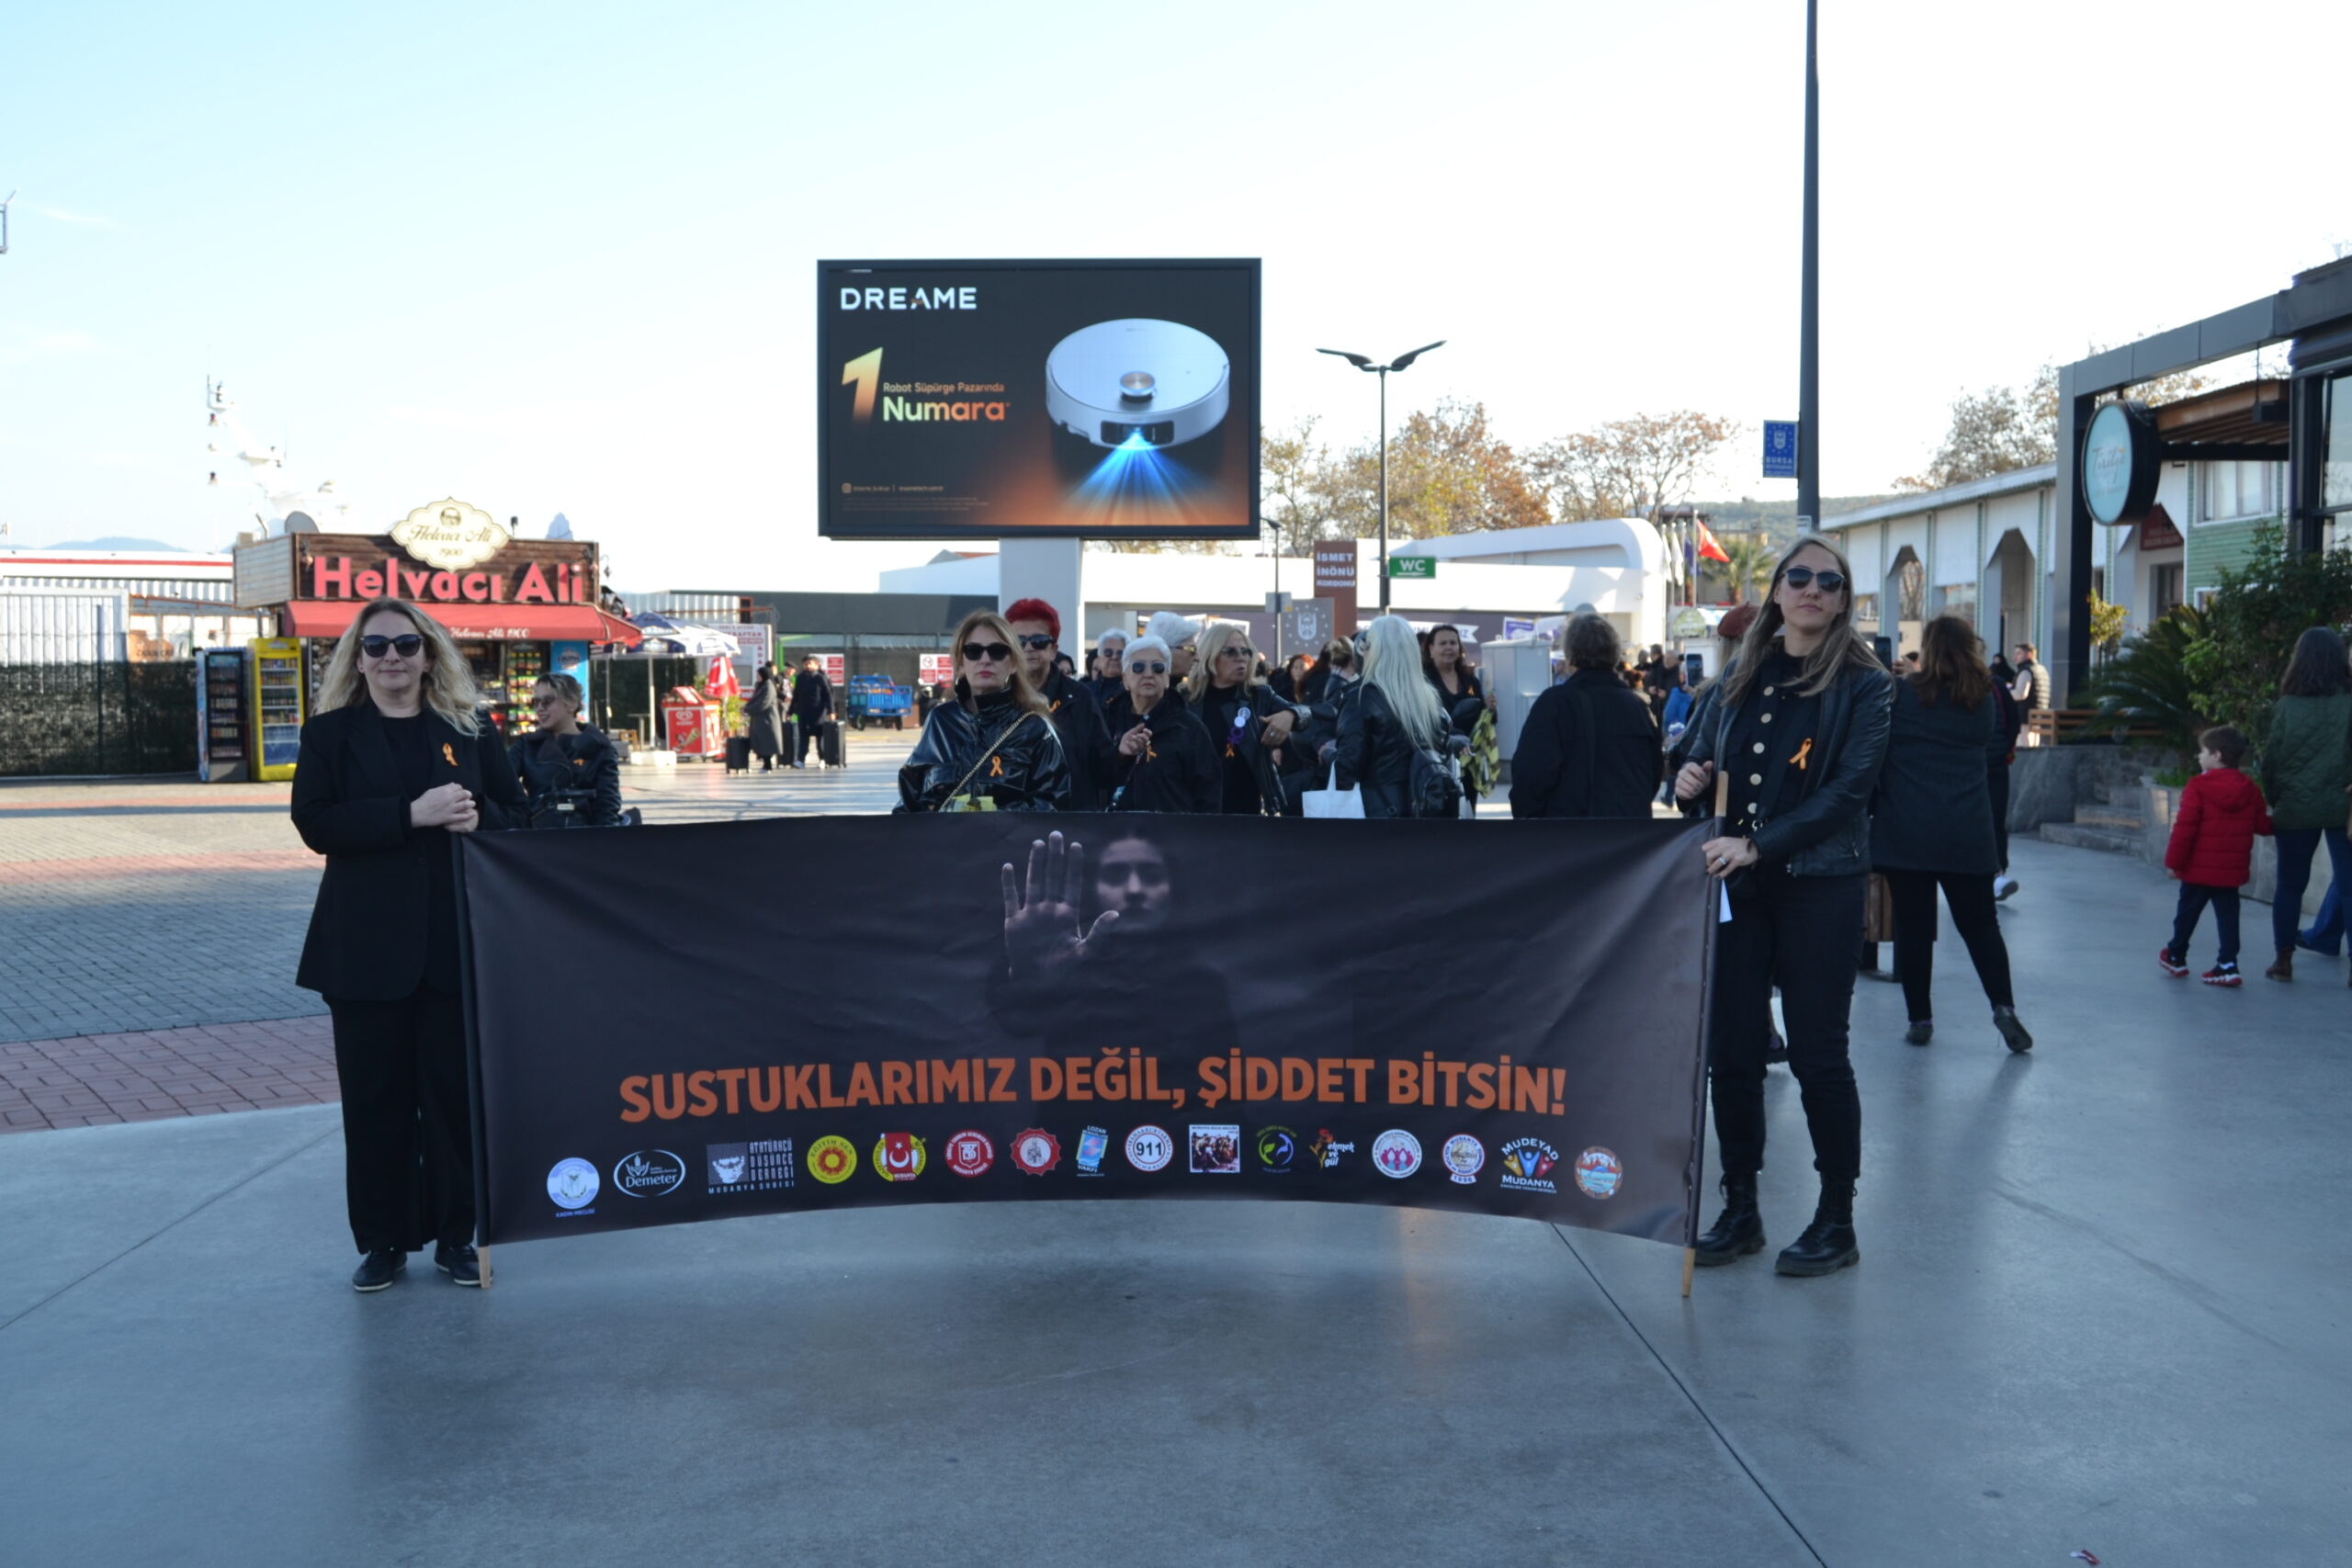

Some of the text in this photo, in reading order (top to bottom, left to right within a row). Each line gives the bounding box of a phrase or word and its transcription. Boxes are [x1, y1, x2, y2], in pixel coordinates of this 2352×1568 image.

[841, 288, 977, 310] DREAME
[842, 346, 883, 424] 1
[883, 382, 1004, 395] Robot Süpürge Pazarında
[883, 396, 1006, 422] Numara
[1317, 552, 1353, 562] İSMET
[1317, 565, 1354, 576] İNÖNÜ
[1400, 559, 1426, 571] WC
[313, 556, 583, 603] Helvacı Ali
[620, 1047, 1566, 1122] SUSTUKLARIMIZ DEĞİL, ŞİDDET BİTSİN!
[1136, 1142, 1161, 1156] 911
[1328, 1141, 1354, 1153] ekmek
[1501, 1138, 1559, 1161] MUDEYAD
[626, 1175, 677, 1188] Demeter
[1502, 1174, 1555, 1189] MUDANYA
